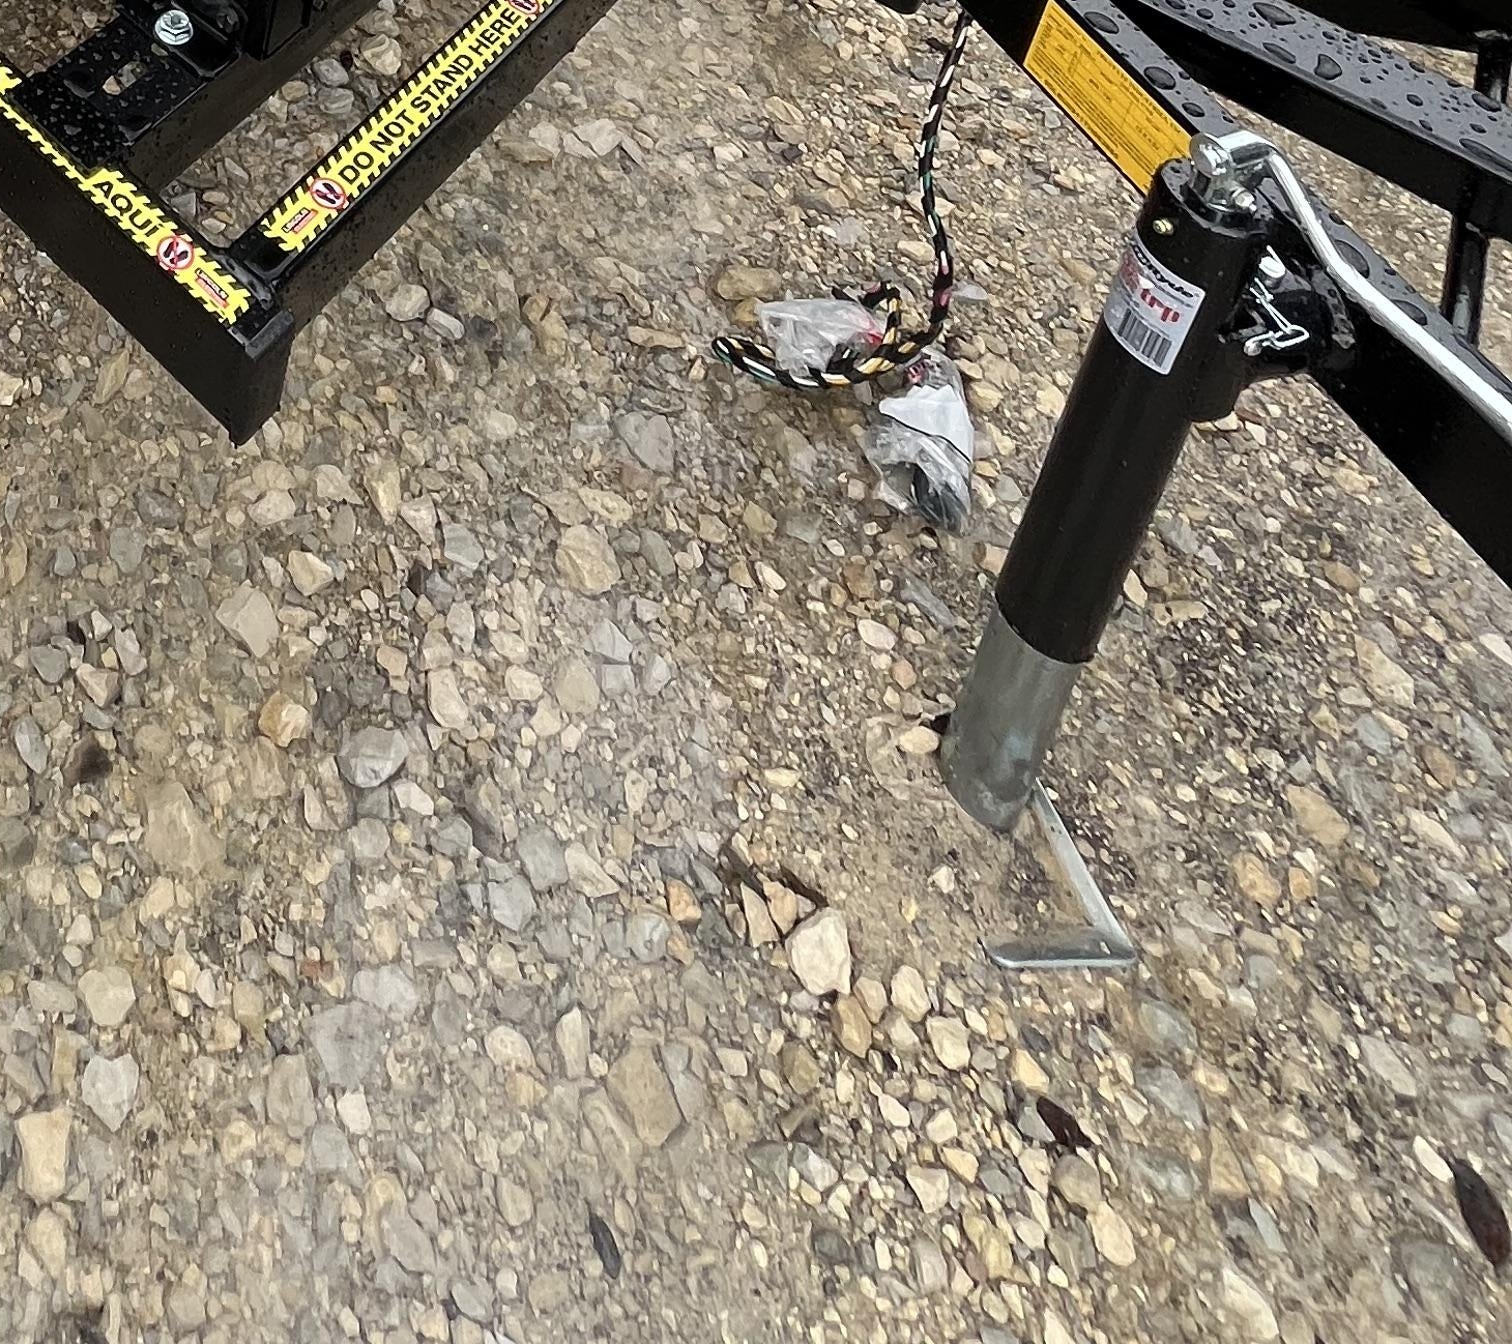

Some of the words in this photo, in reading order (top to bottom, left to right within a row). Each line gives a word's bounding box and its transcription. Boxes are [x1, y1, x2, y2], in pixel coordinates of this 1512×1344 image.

[338, 150, 374, 186] DO
[369, 109, 415, 153] NOT
[410, 55, 474, 113] STAND
[468, 8, 520, 55] HERE
